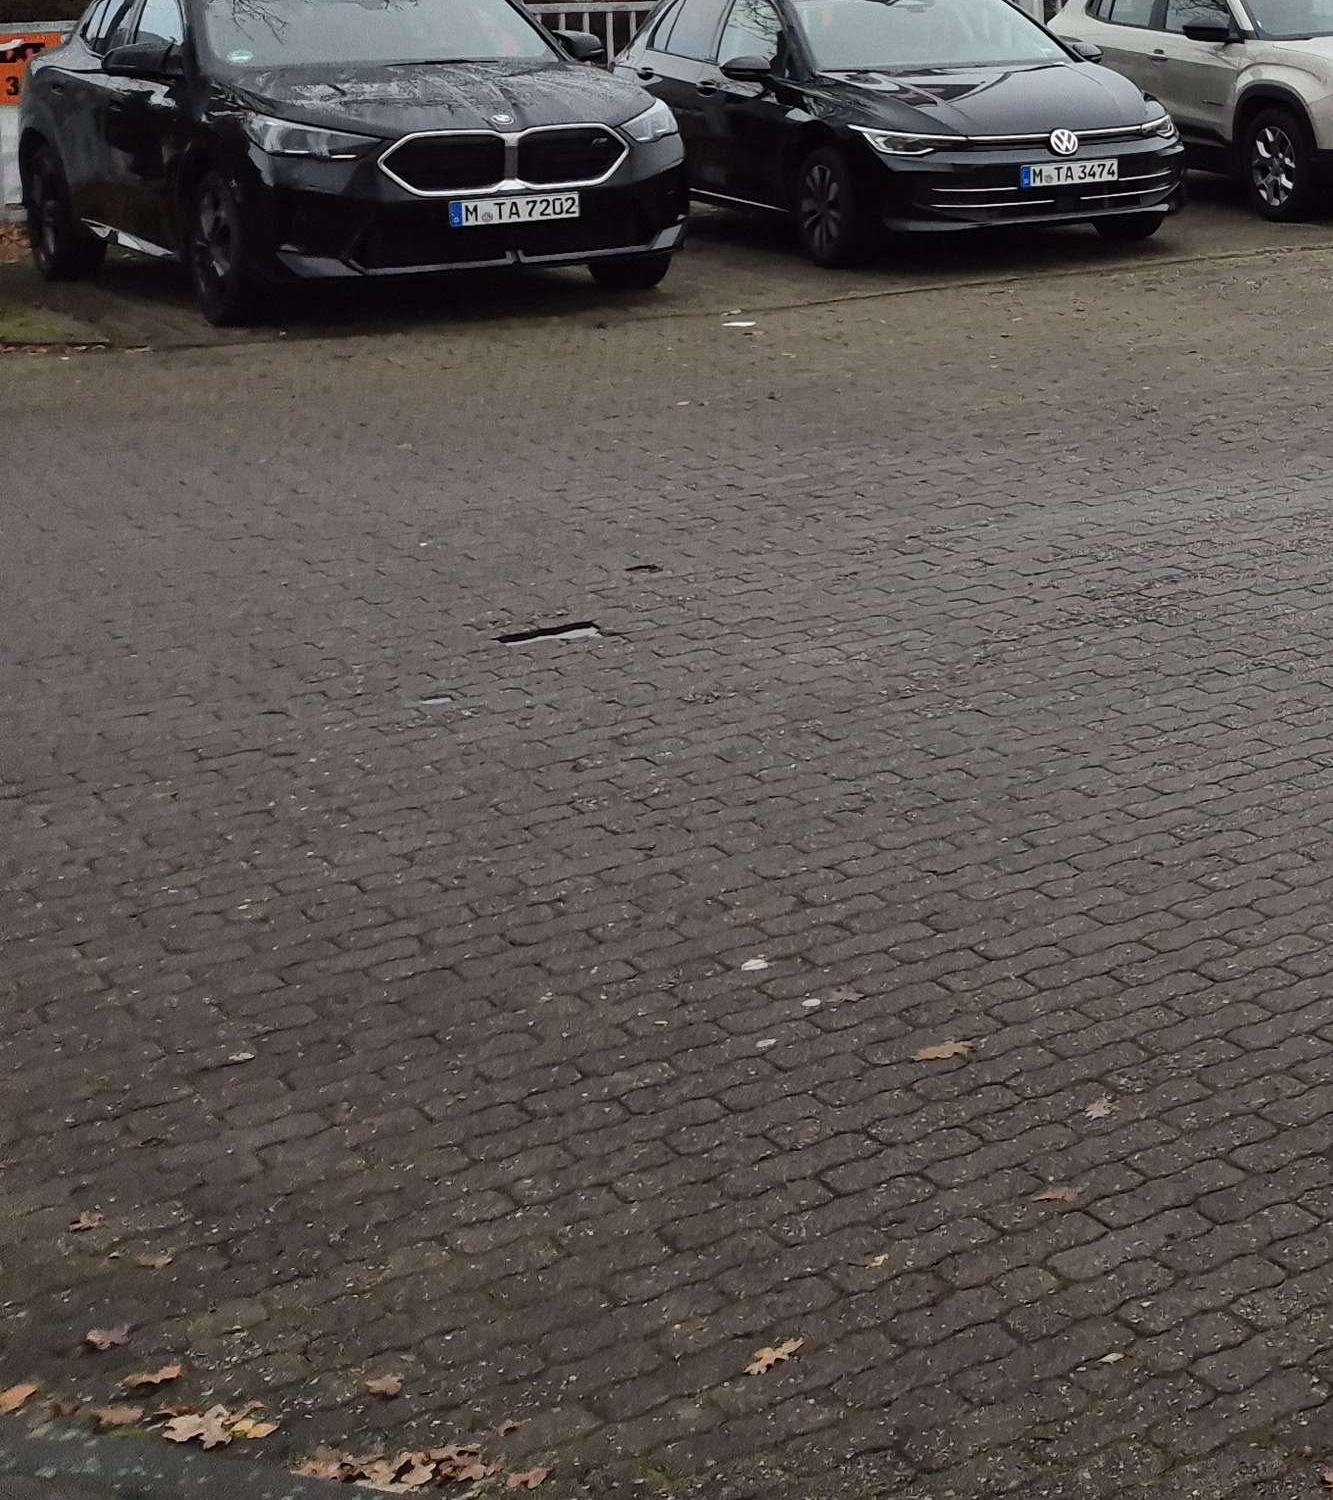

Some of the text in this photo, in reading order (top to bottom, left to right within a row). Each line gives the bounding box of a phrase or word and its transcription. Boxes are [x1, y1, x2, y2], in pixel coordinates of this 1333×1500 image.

[1032, 162, 1115, 184] M TA 3474
[464, 204, 479, 223] M
[494, 201, 521, 220] TA
[526, 196, 577, 217] 7202
